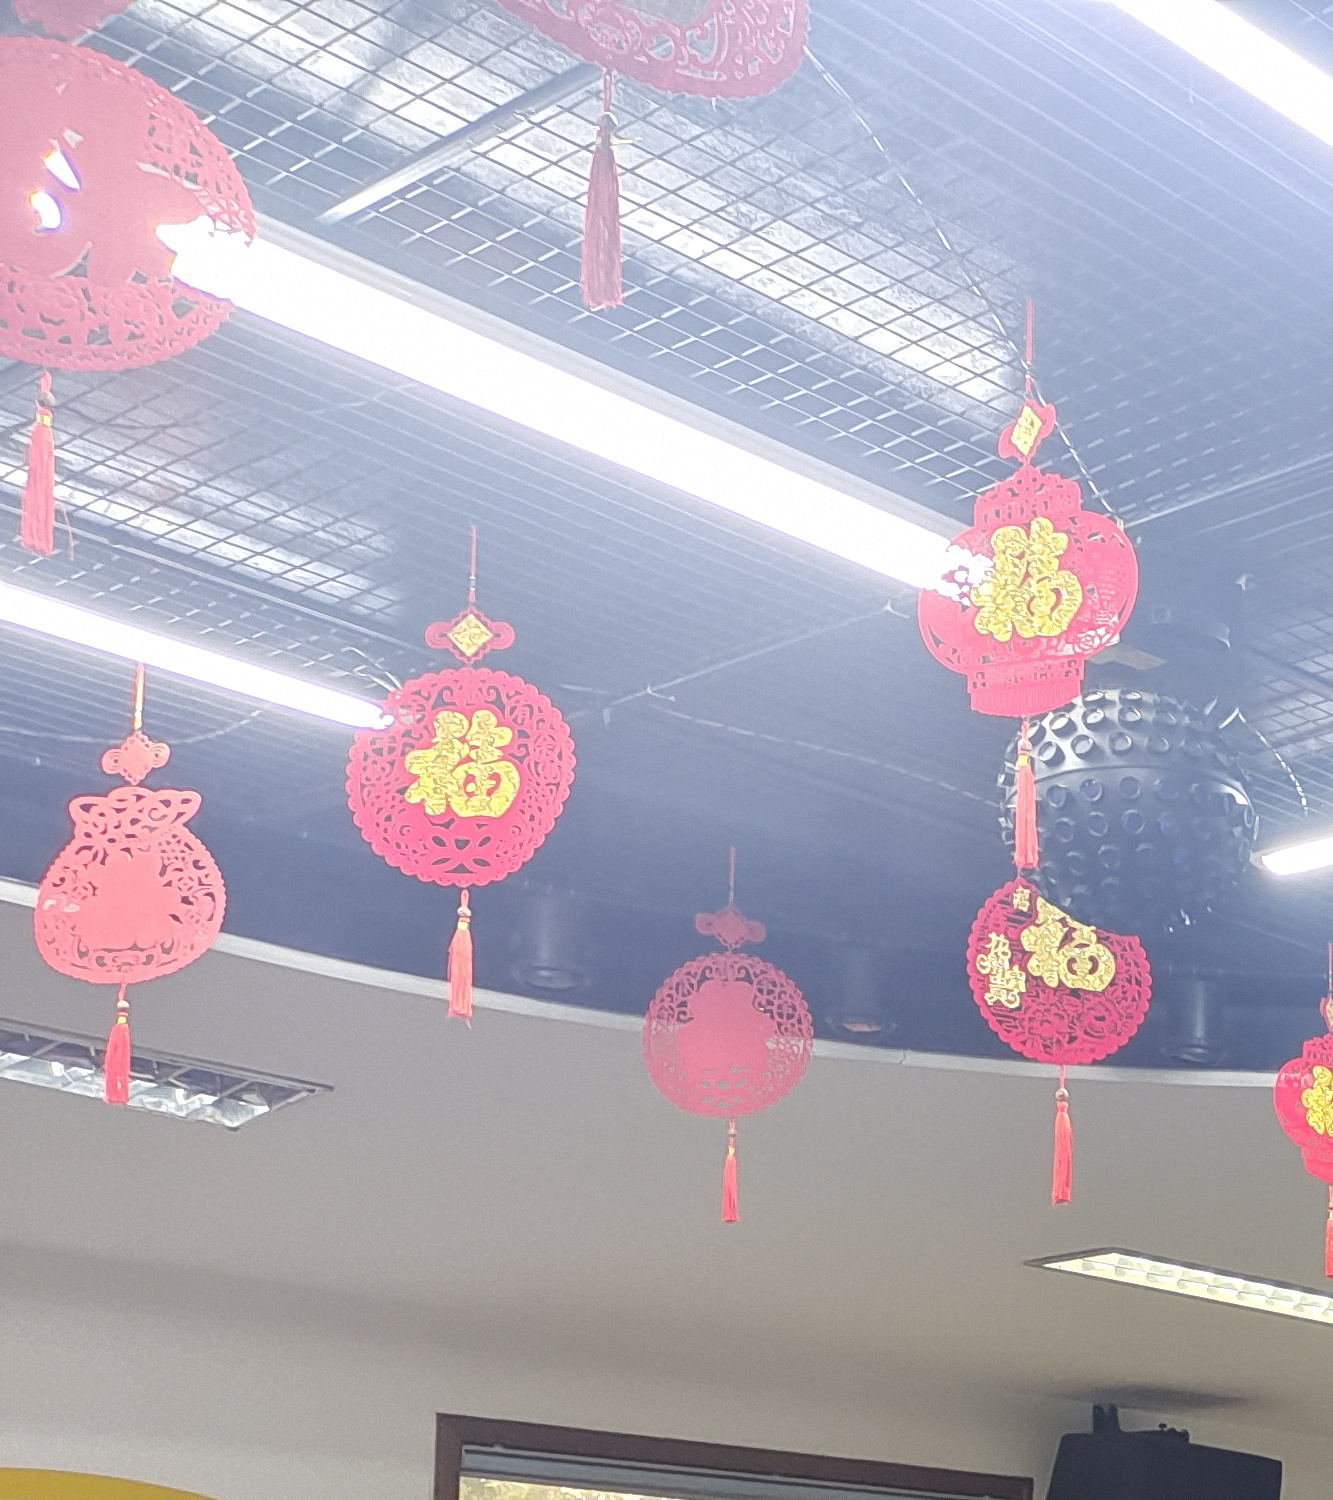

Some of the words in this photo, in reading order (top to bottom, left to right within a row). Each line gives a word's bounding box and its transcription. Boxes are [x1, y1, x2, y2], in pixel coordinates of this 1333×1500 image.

[970, 517, 1083, 642] 福
[404, 709, 520, 818] 福
[1021, 896, 1116, 992] 福
